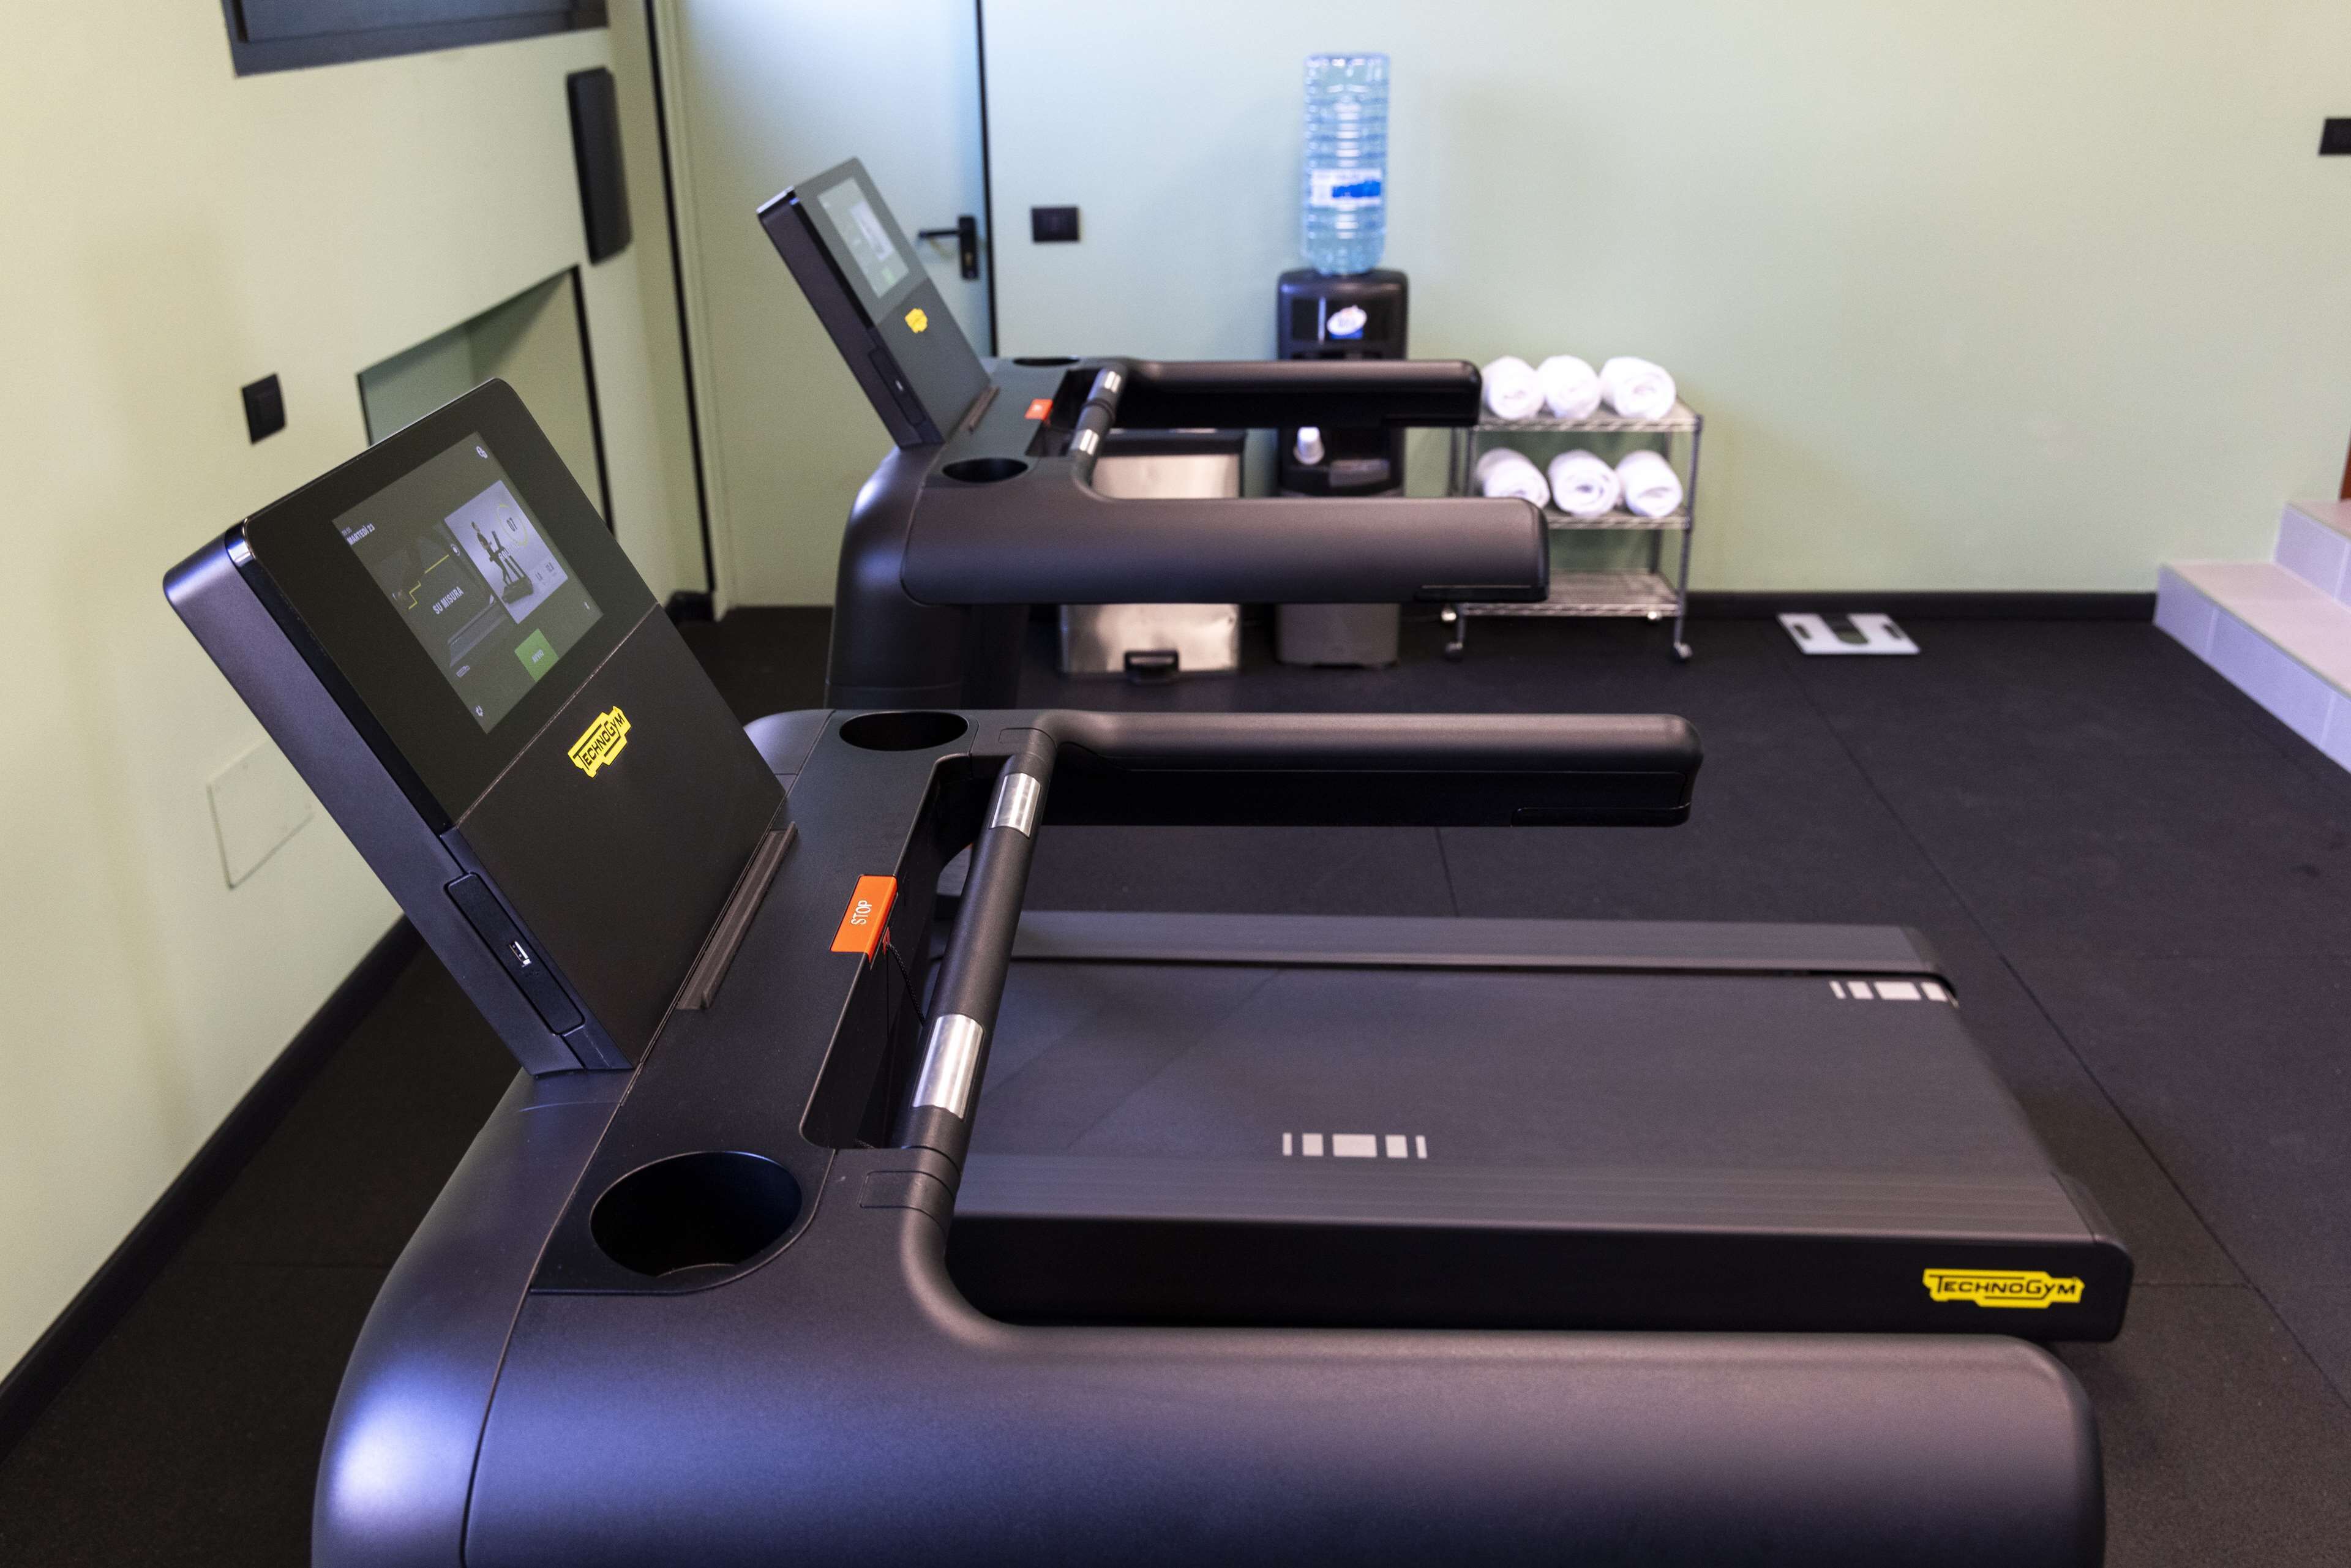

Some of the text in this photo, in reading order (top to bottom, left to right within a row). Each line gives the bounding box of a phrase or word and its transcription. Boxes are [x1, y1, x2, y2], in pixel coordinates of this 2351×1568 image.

[433, 586, 464, 615] SU MISURA
[572, 712, 626, 771] TECHNOGYM
[850, 899, 872, 925] STOP
[1929, 1274, 2077, 1300] TECHNOGYM
